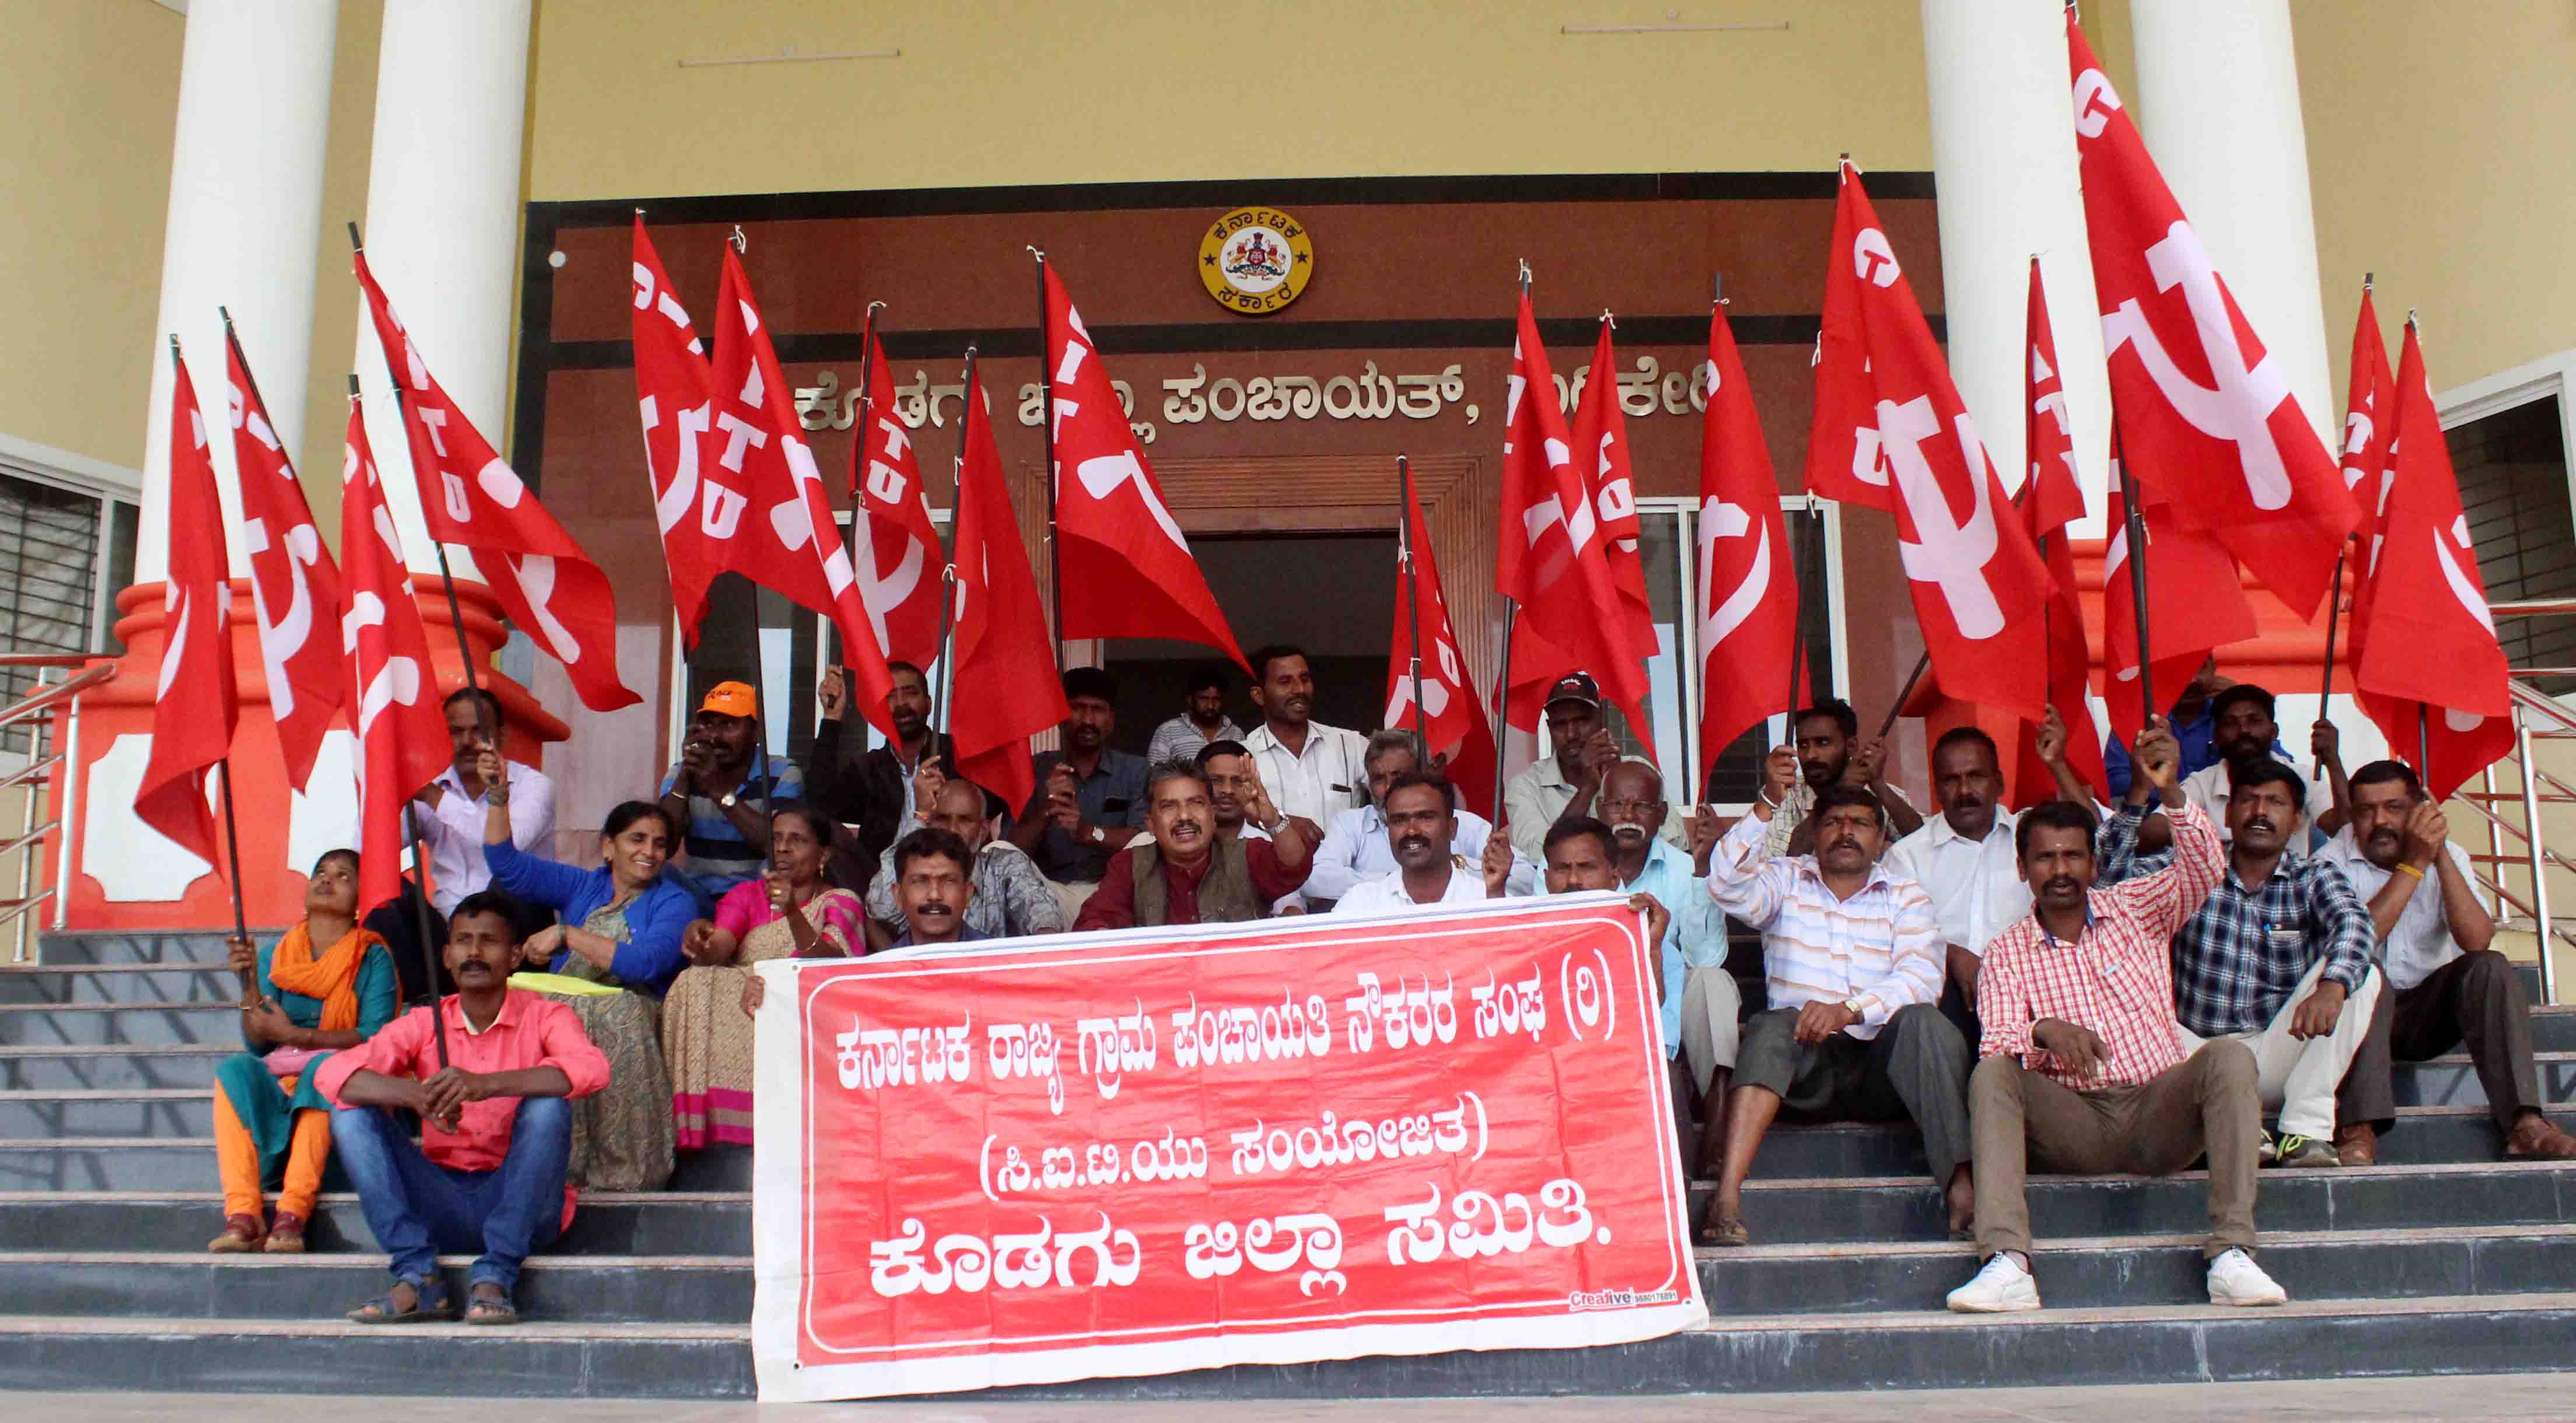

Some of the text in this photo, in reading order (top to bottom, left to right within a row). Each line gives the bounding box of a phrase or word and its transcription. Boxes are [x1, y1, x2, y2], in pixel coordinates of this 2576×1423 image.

[1213, 212, 1303, 240] ಕರ್ನಾಟಕ
[1219, 282, 1292, 309] ಸರ್ಕಾರ
[1163, 360, 1479, 425] ಪಂಚಾಯತ್,
[836, 949, 1615, 1115] ಕರ್ನಾಟಕ ರಾಜ್ಯ ಗ್ರಾಮ ಪಂಚಾಯತಿ ನೌಕರರ ಸಂಘ (ರಿ)
[980, 1091, 1489, 1201] (ಸಿ.ಐ.ಟಿ.ಯು ಸಂಯೋಜಿತ)
[870, 1179, 1612, 1297] ಕೊಡಗು ಜಿಲ್ಲಾ ಸಮಿತಿ.
